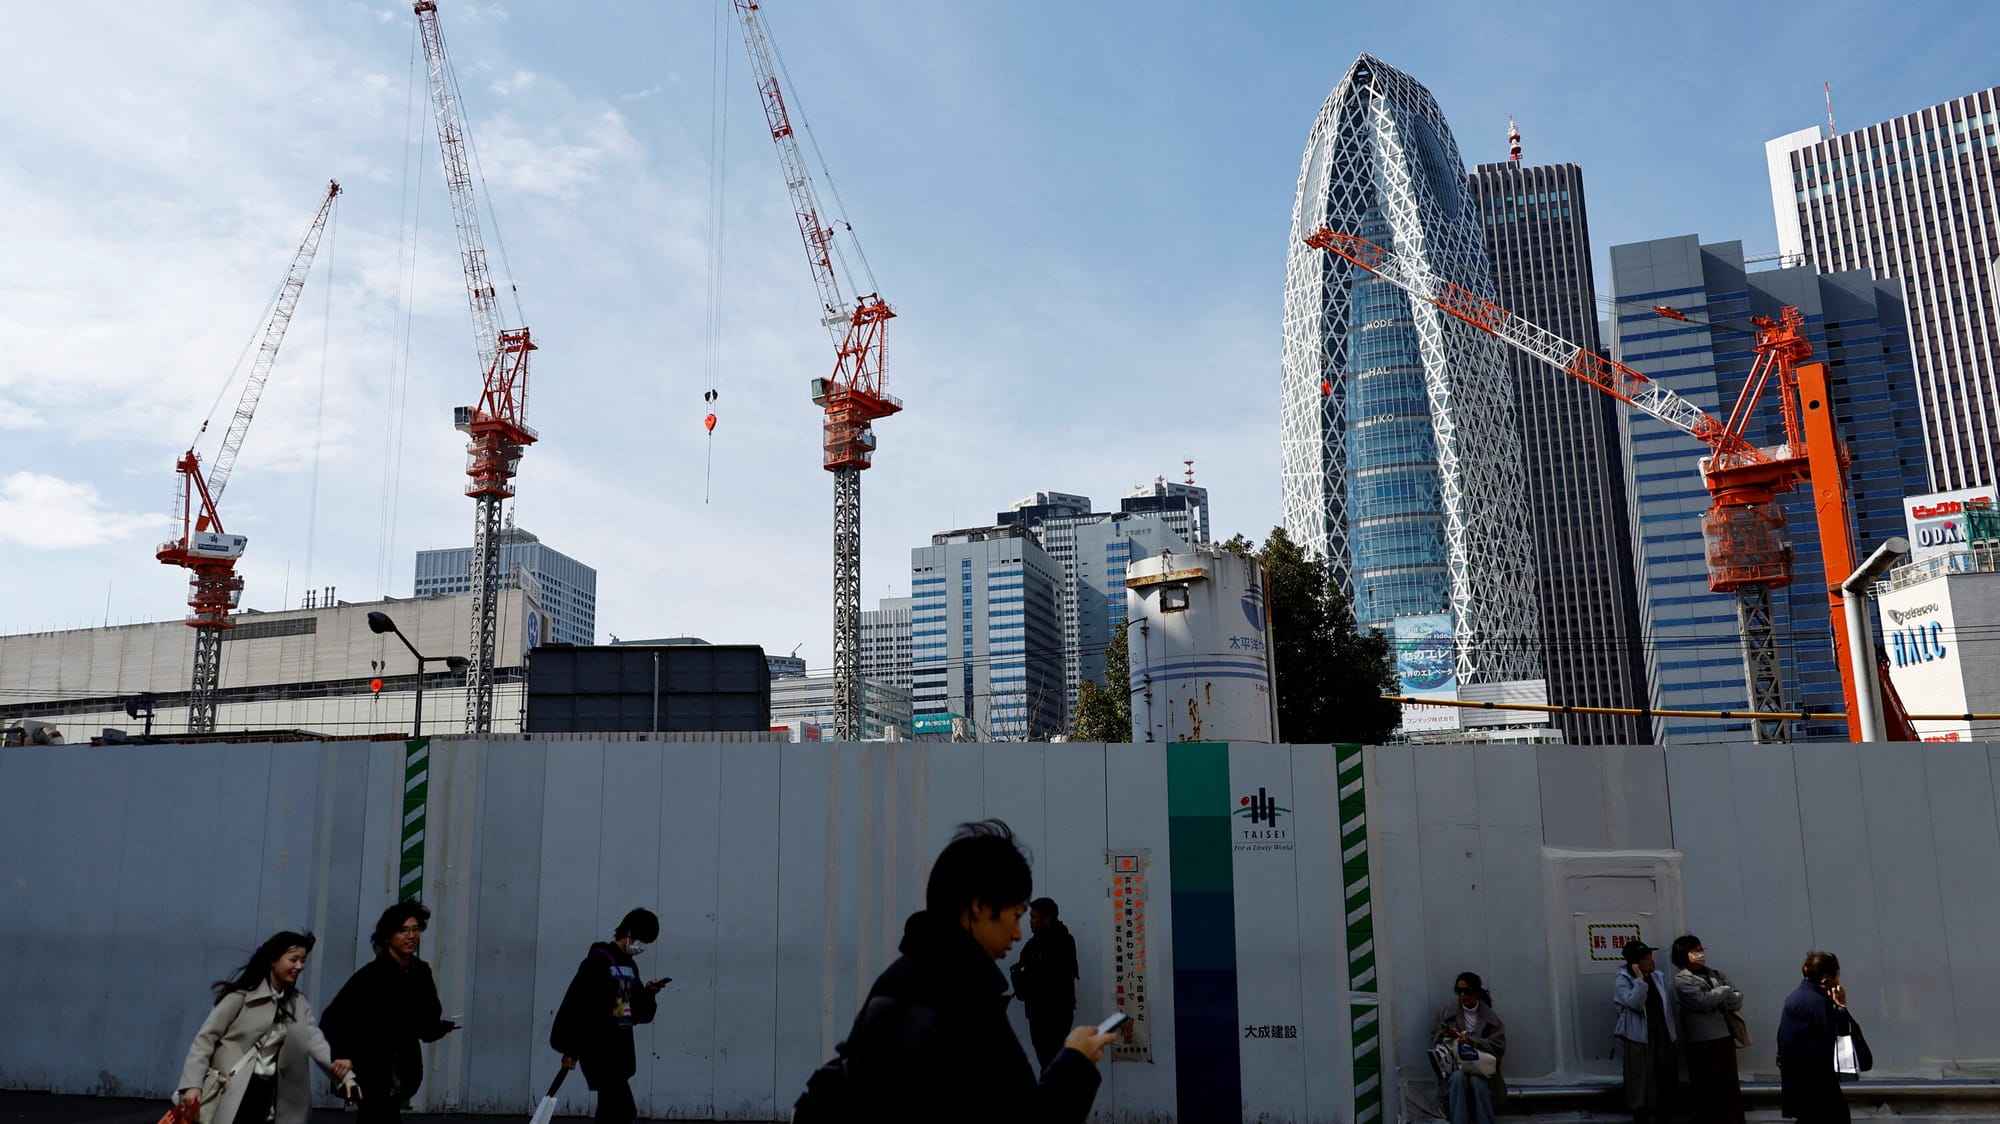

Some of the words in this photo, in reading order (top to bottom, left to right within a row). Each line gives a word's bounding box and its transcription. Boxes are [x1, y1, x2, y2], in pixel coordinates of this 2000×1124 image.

[1366, 319, 1393, 330] MODE
[1369, 366, 1391, 377] HAL
[1892, 620, 1946, 668] HALC
[1244, 830, 1285, 839] TAISEI
[1252, 844, 1272, 852] Lively
[1244, 1024, 1298, 1039] 大成建設
